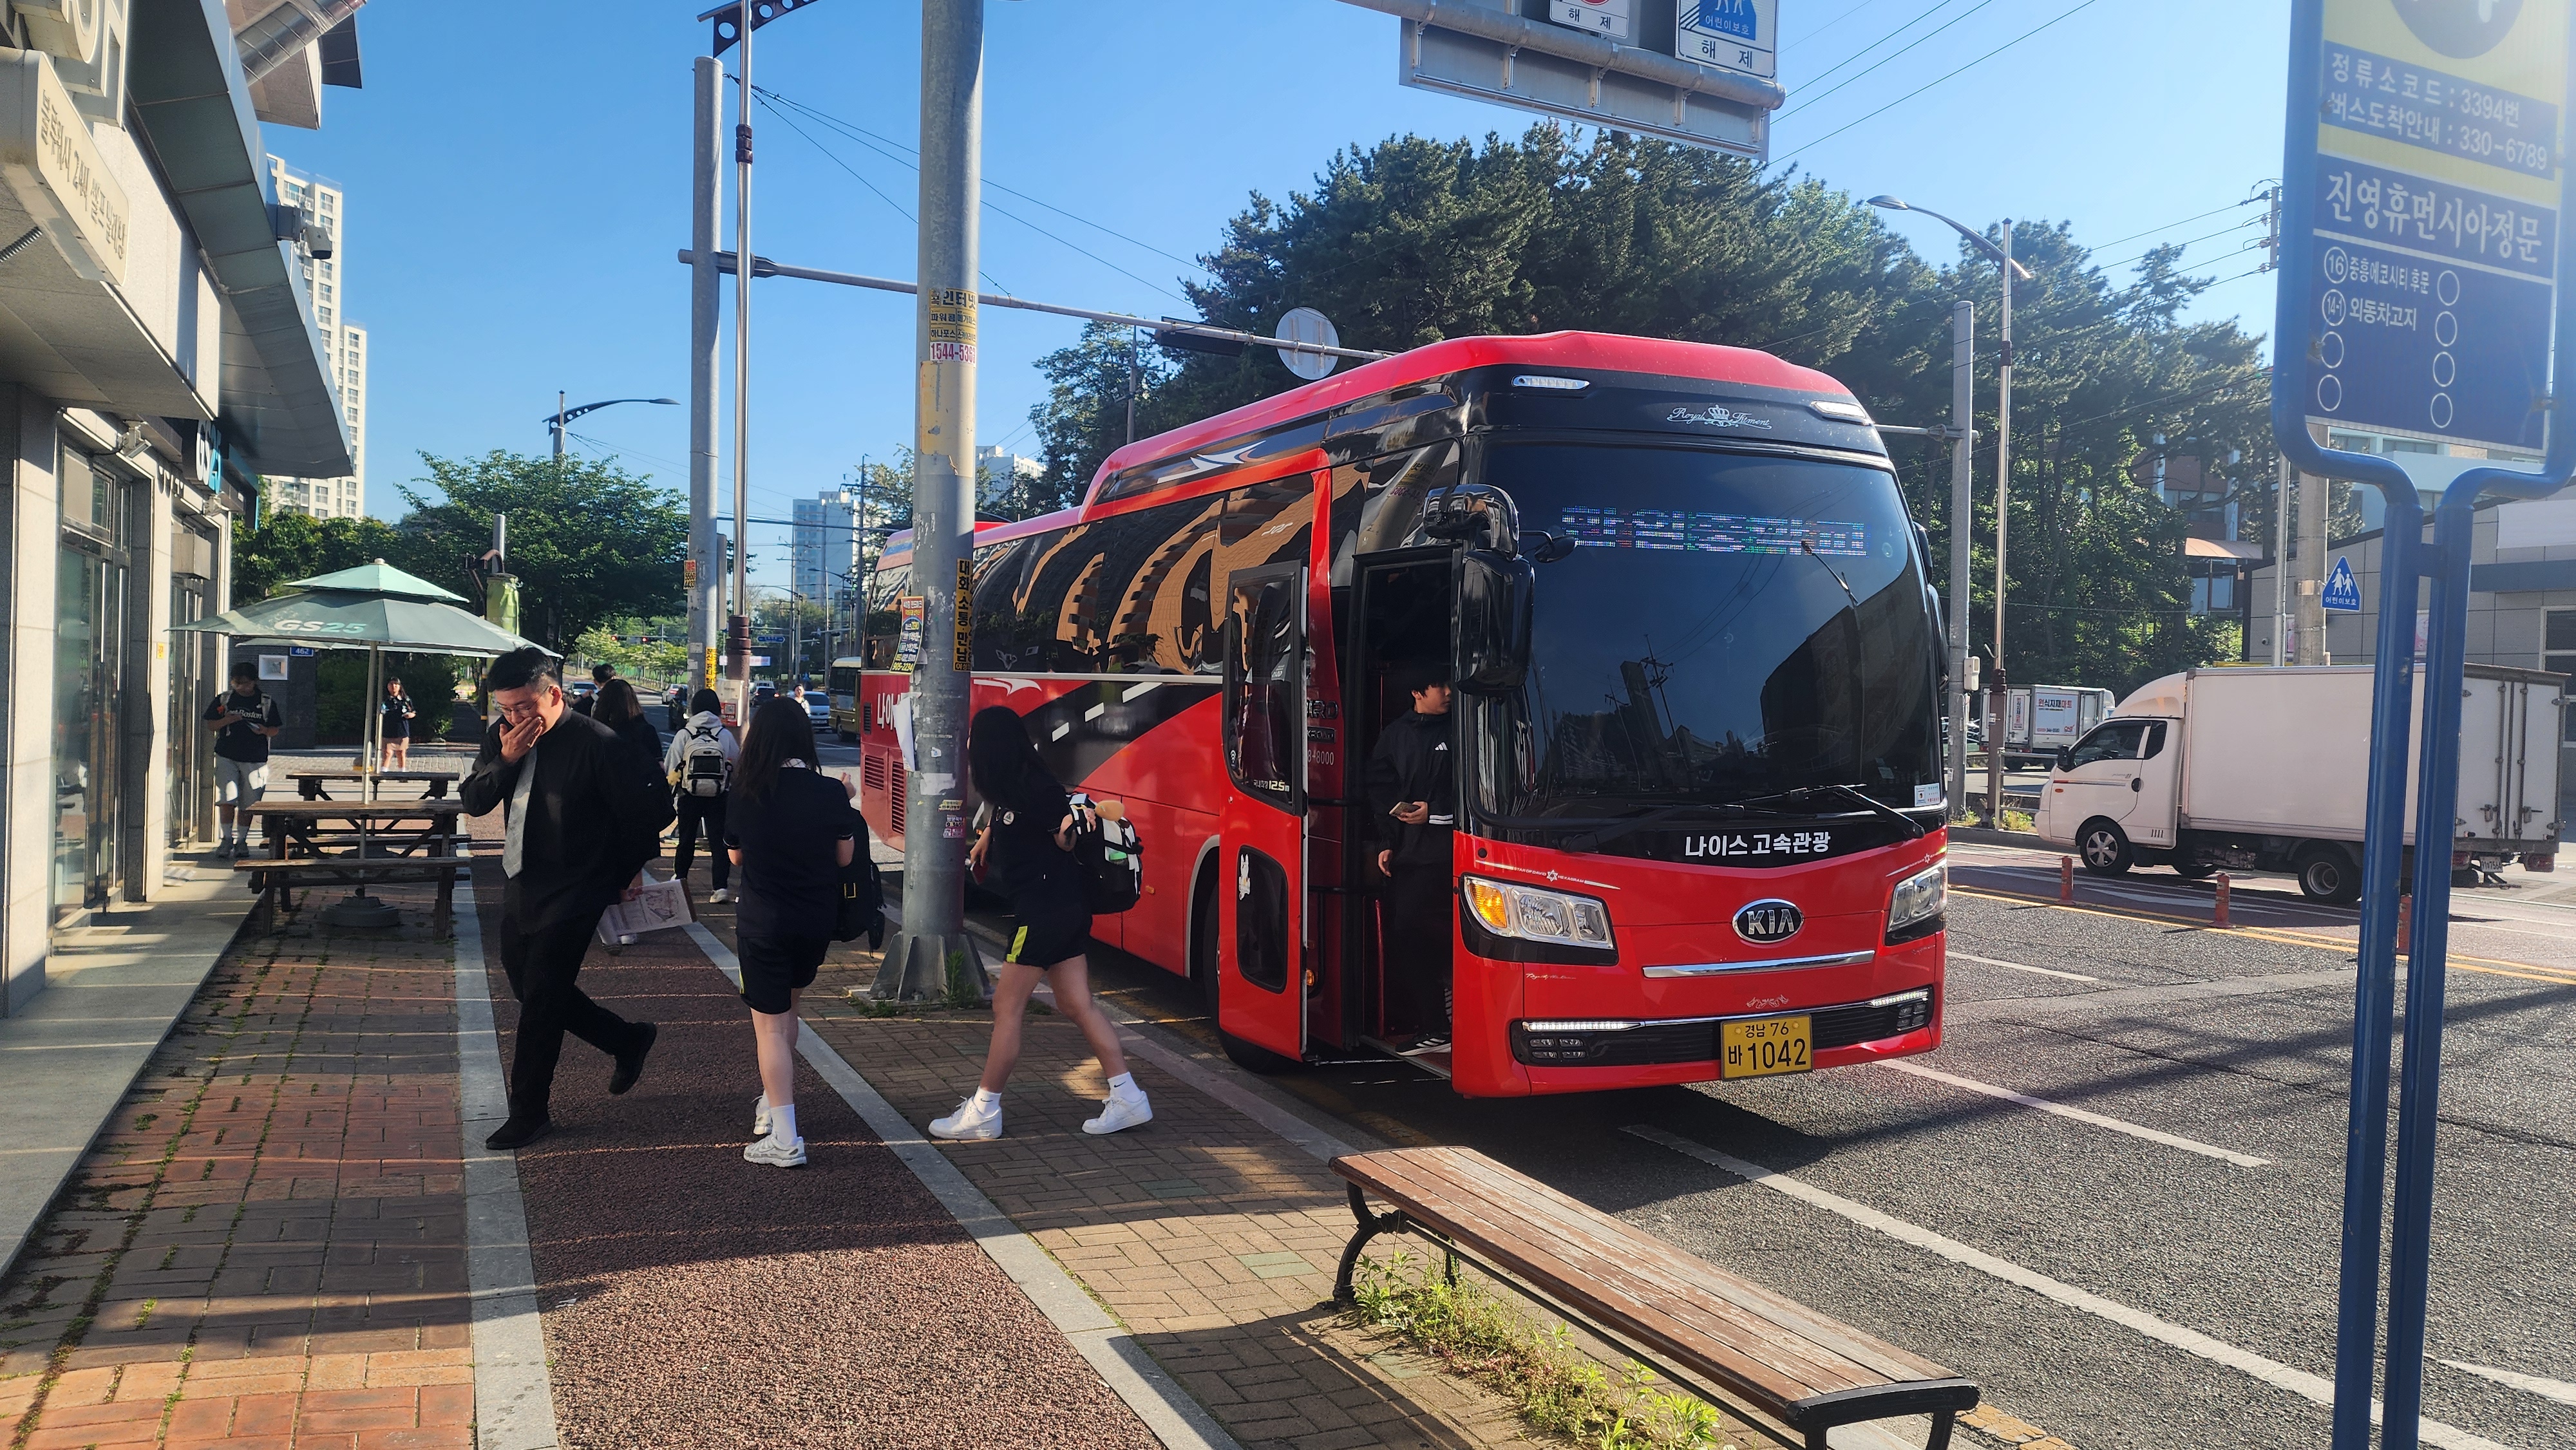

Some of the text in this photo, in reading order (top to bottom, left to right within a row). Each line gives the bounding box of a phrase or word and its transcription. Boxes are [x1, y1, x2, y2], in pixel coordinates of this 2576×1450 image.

[1705, 15, 1749, 35] 어린이보호
[2331, 51, 2443, 106] 정류소코드
[2460, 88, 2520, 129] 3394번
[2329, 91, 2441, 146] 버스도착안내
[2459, 126, 2548, 171] 330-6789
[2325, 171, 2543, 263] 진영휴먼시아정문
[2328, 254, 2430, 294] 16 중흥에코시티 후문
[943, 290, 976, 310] 인터넷
[931, 314, 955, 322] 파워콤
[2327, 296, 2416, 331] 14-1 외동차고지
[931, 329, 956, 338] 하나포스
[1670, 407, 1707, 424] Royal
[196, 420, 221, 494] GS25
[2325, 596, 2356, 605] 어린이보호
[274, 619, 367, 634] GS25
[2038, 699, 2072, 708] 원식자재마트
[239, 709, 262, 719] Boston
[1747, 908, 1795, 936] KIA
[1745, 1022, 1789, 1038] 경남 76
